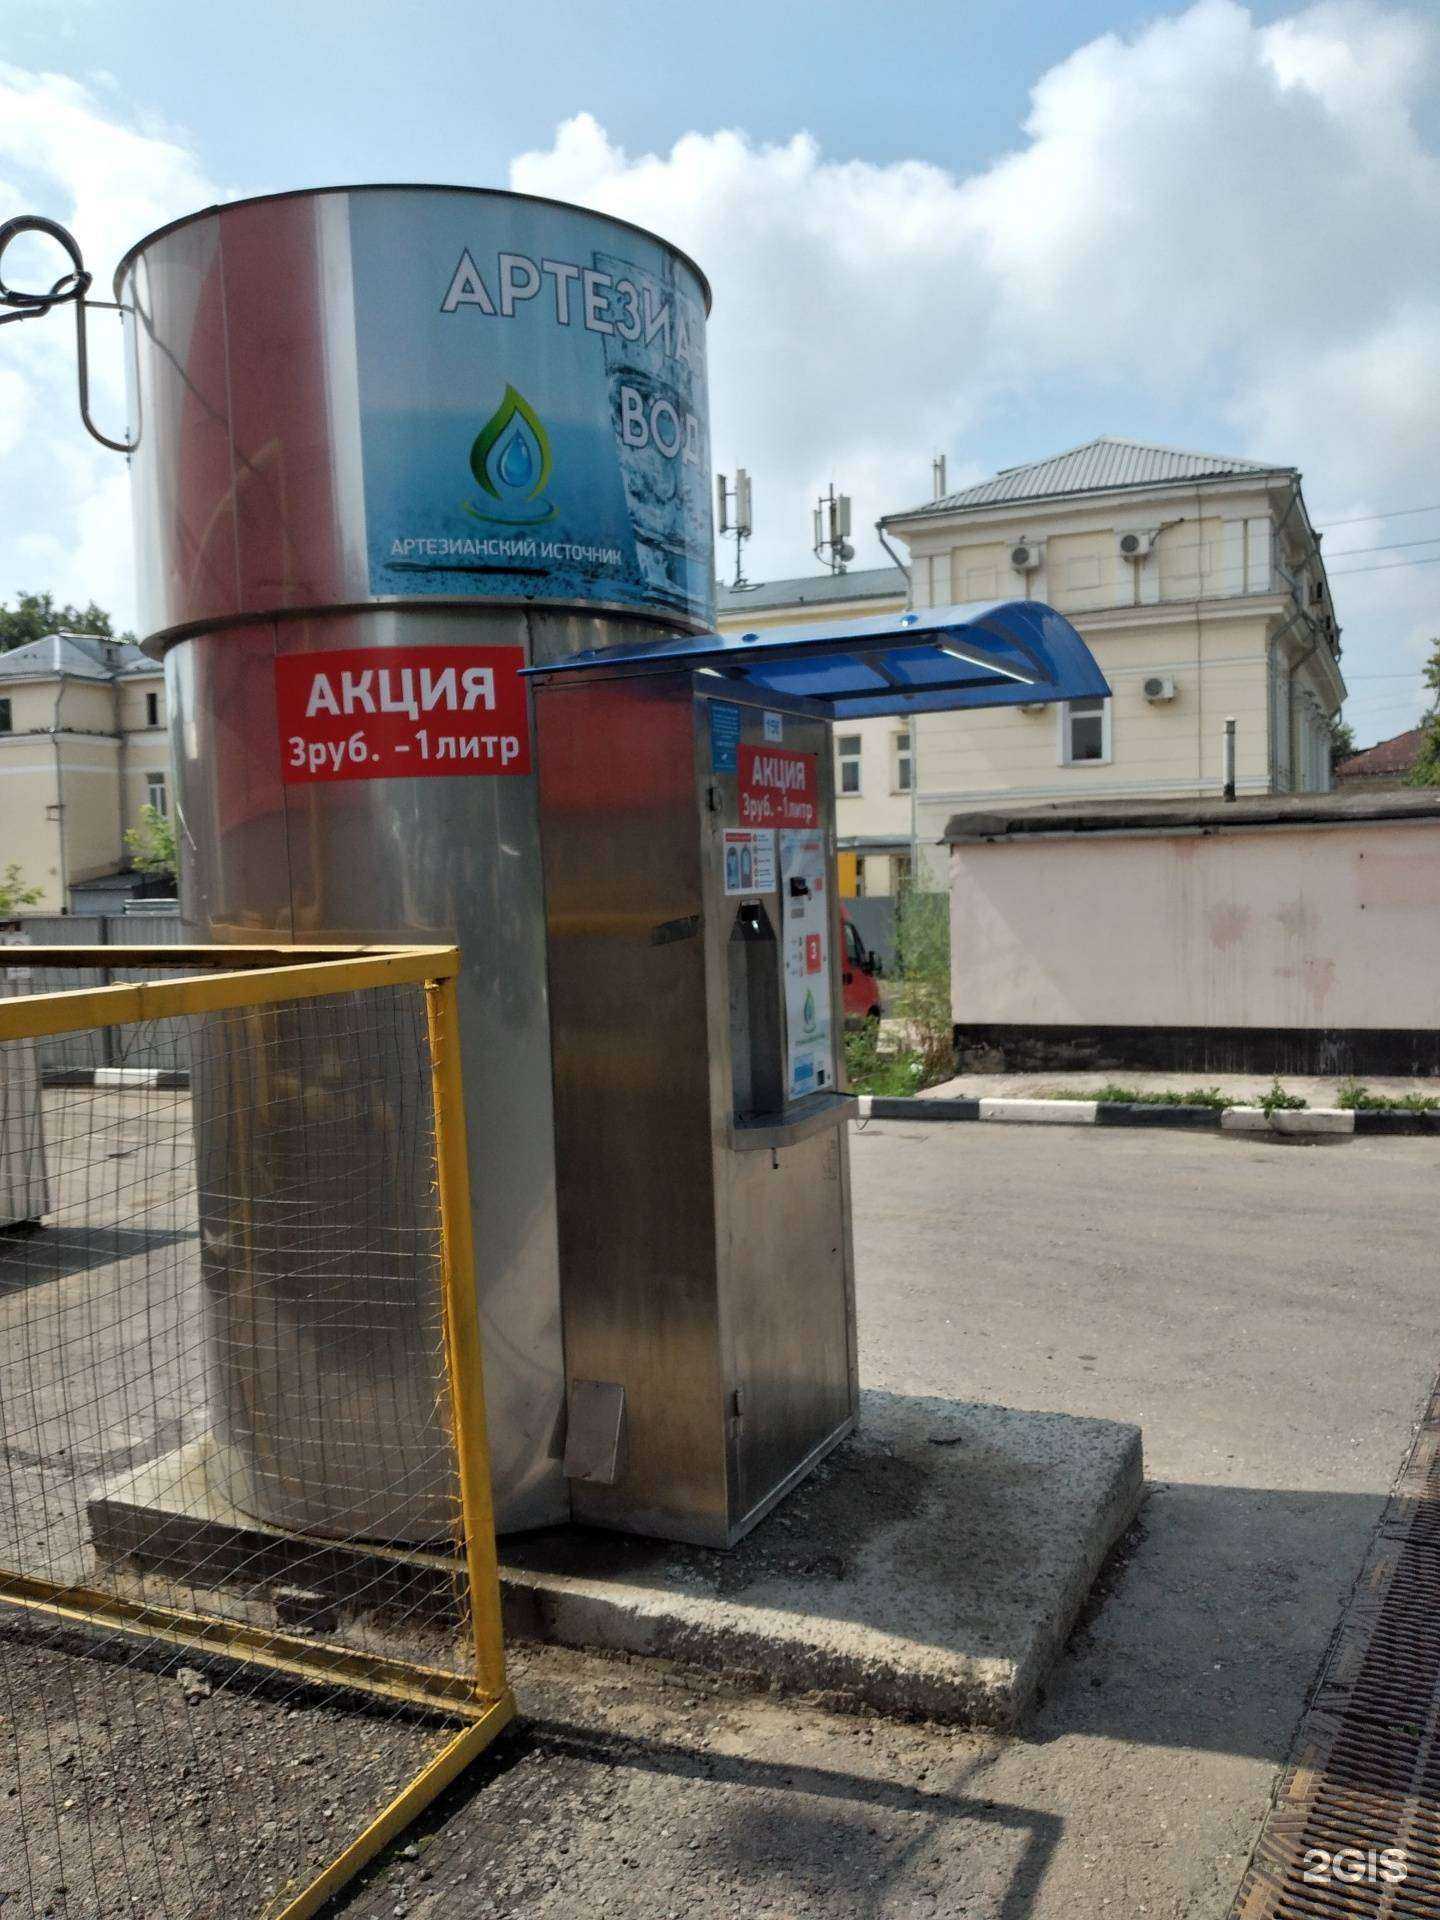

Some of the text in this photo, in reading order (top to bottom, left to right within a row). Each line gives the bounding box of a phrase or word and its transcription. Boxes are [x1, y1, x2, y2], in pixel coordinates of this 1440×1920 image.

[391, 536, 623, 566] АРТЕЗИАНСКИЙ ИСТОЧНИК
[304, 667, 496, 721] АКЦИЯ
[287, 730, 380, 774] 3руб.
[751, 754, 807, 794] АКЦИЯ
